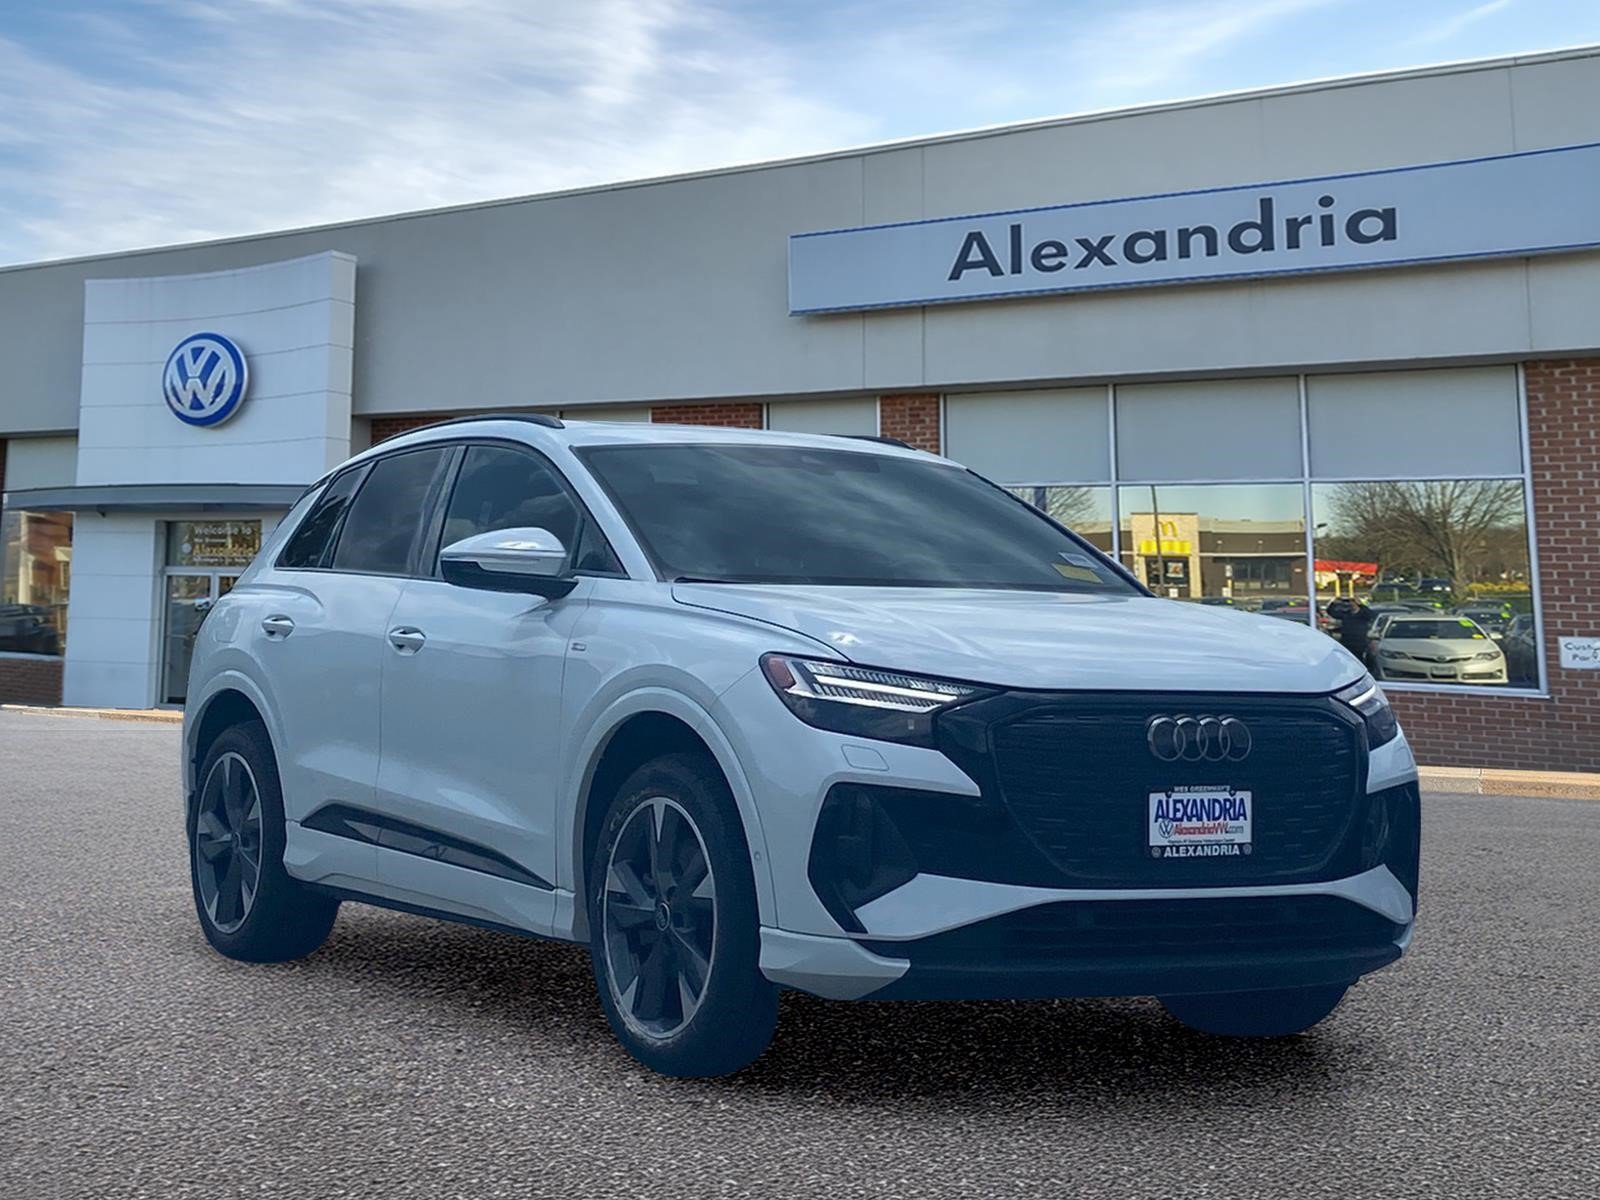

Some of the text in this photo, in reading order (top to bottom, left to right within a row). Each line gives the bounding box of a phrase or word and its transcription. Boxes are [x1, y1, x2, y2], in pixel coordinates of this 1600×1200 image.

[947, 194, 1398, 282] Alexandria
[166, 338, 238, 418] VW
[1154, 798, 1247, 823] ALEXANDRIA
[1164, 844, 1240, 858] ALEXANDRIA
